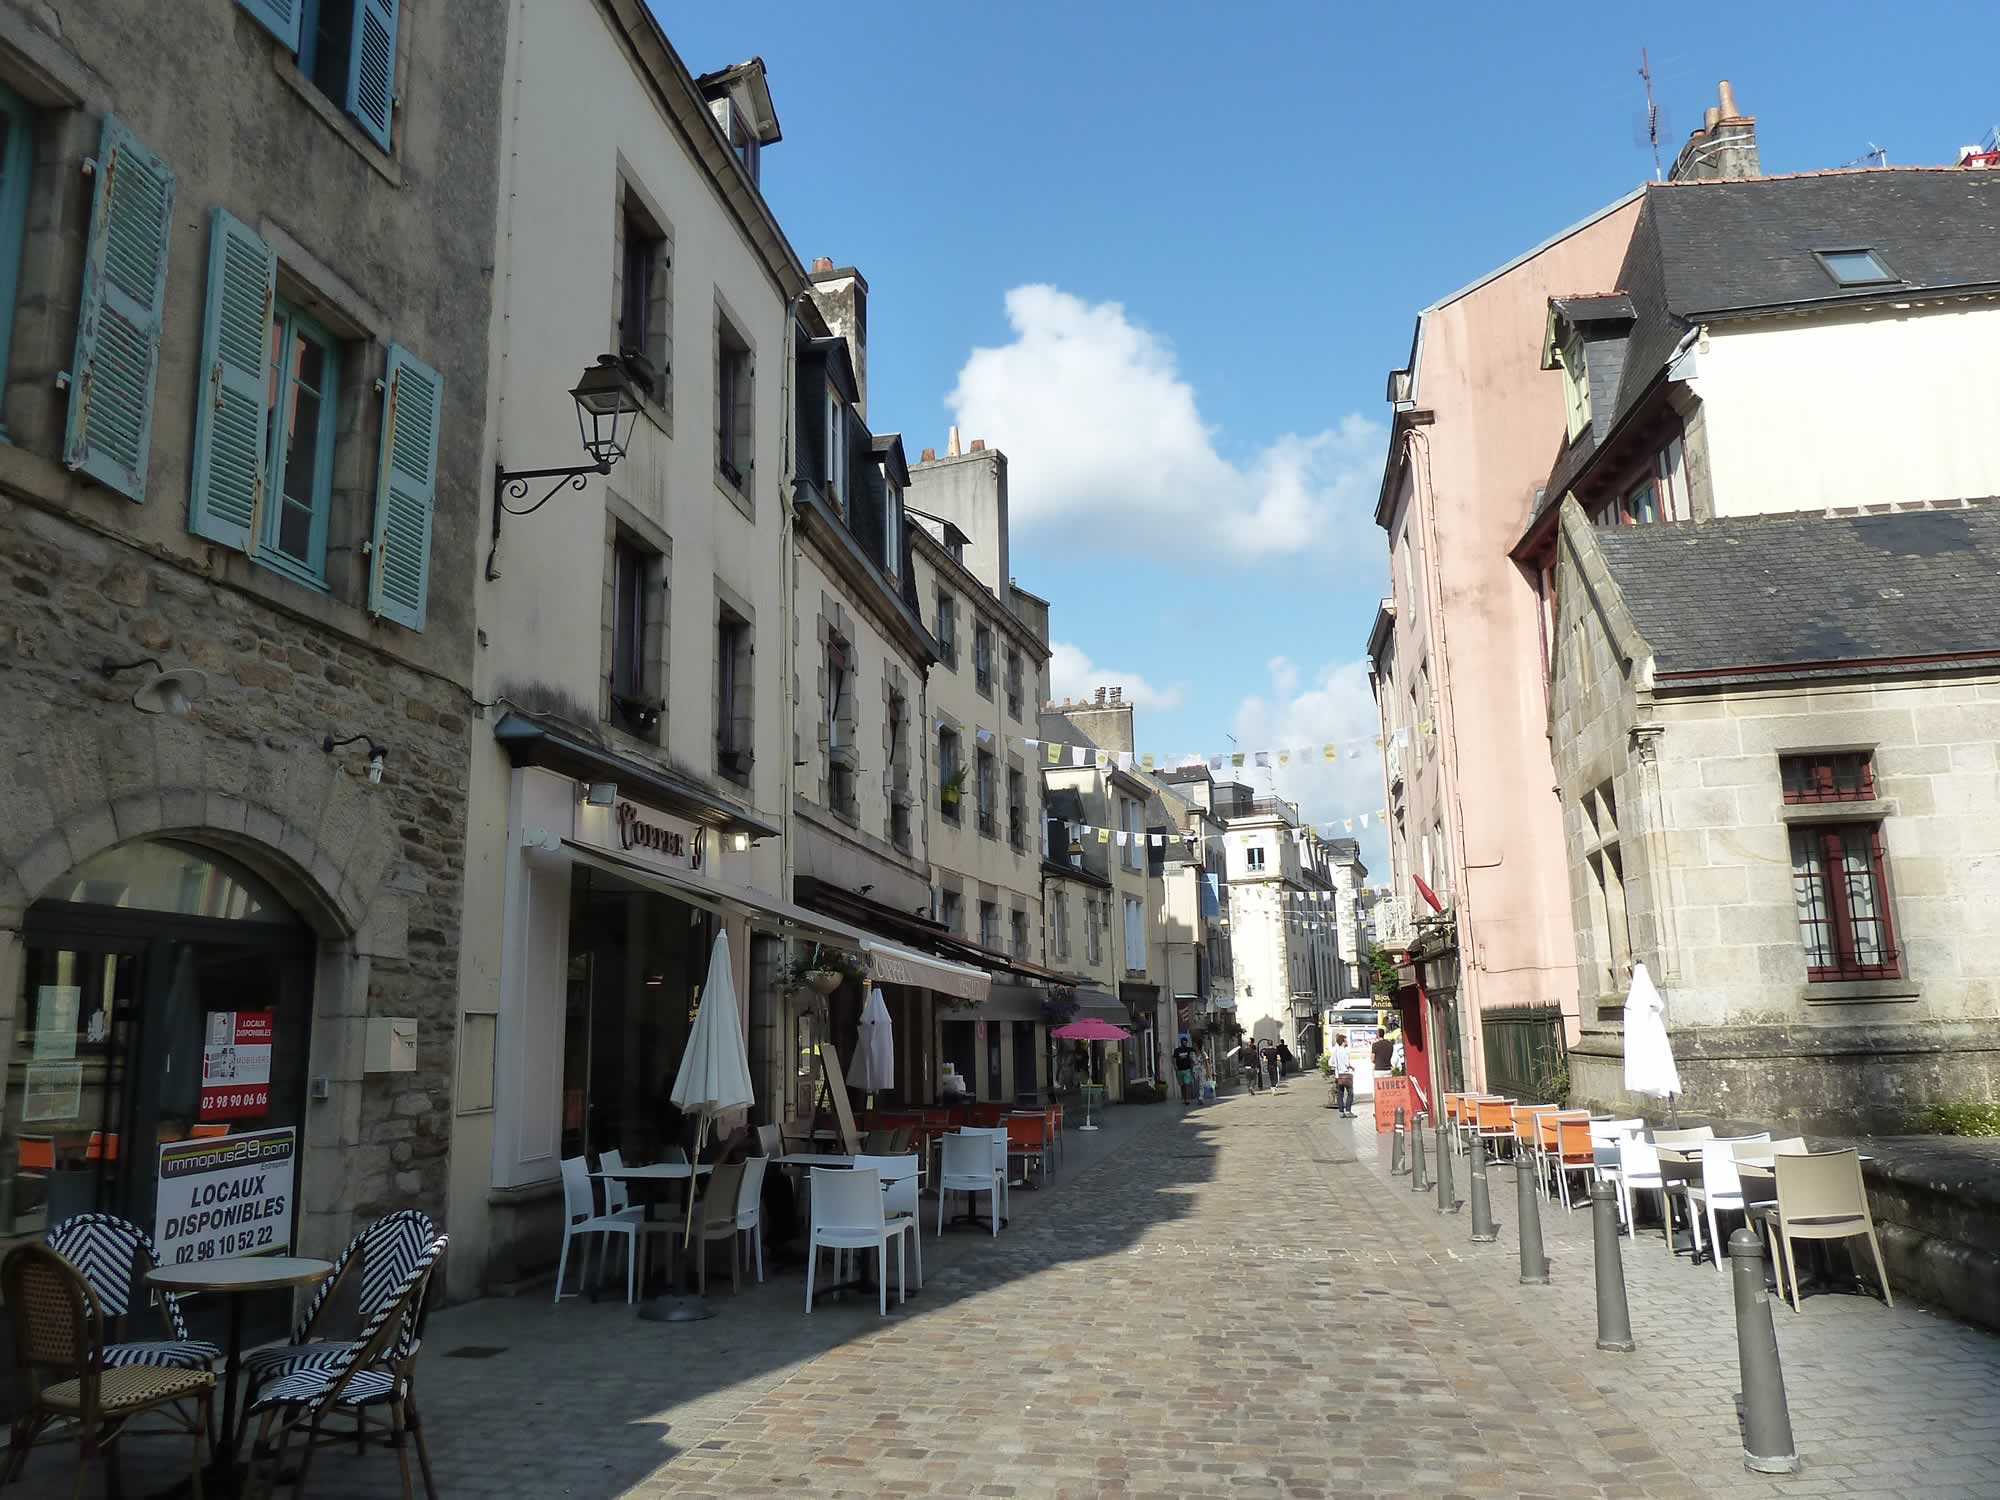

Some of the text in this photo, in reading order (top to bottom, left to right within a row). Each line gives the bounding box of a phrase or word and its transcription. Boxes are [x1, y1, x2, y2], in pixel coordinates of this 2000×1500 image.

[236, 1029, 272, 1037] DISPONIBLES
[243, 1020, 266, 1028] LOCAUX
[1376, 1080, 1406, 1090] LIVRES
[202, 1092, 268, 1109] 02 98 90 06 06
[167, 1139, 290, 1172] immoplus29.com
[190, 1174, 267, 1208] LOCAUX
[164, 1195, 286, 1241] DISPONIBLES
[175, 1225, 273, 1264] 02 98 10 52 22
